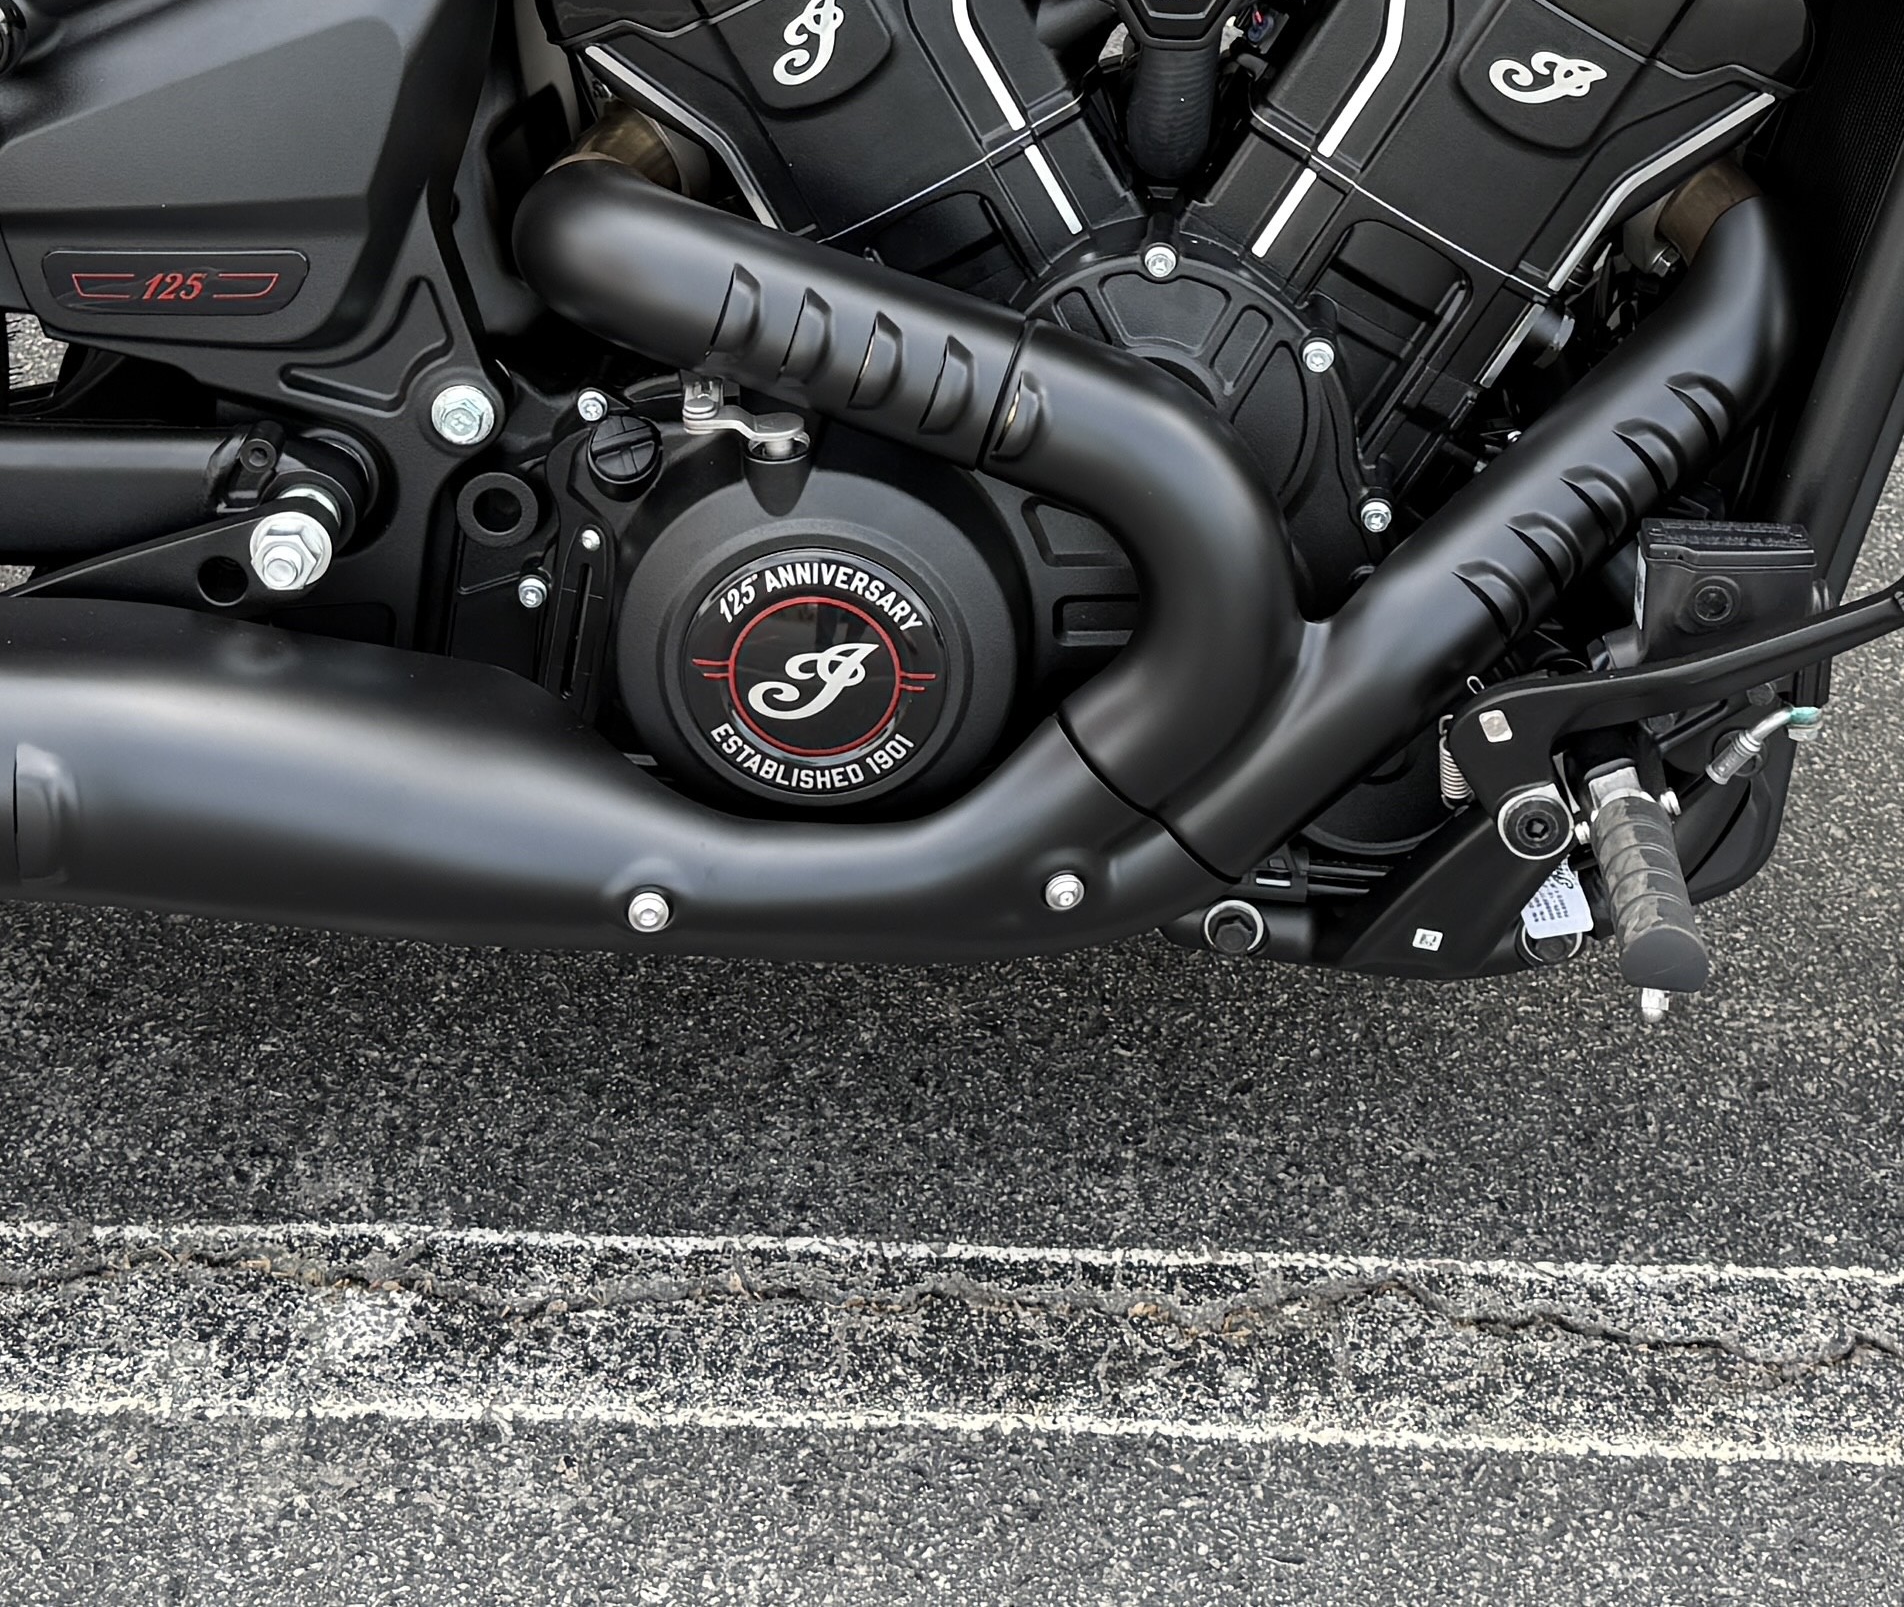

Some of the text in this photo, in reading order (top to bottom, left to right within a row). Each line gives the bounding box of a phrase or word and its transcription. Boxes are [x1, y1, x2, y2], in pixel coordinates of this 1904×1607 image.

[141, 272, 208, 301] 125
[764, 562, 923, 632] ANNIVERSARY
[709, 722, 915, 790] ESTABLISHED 1901
